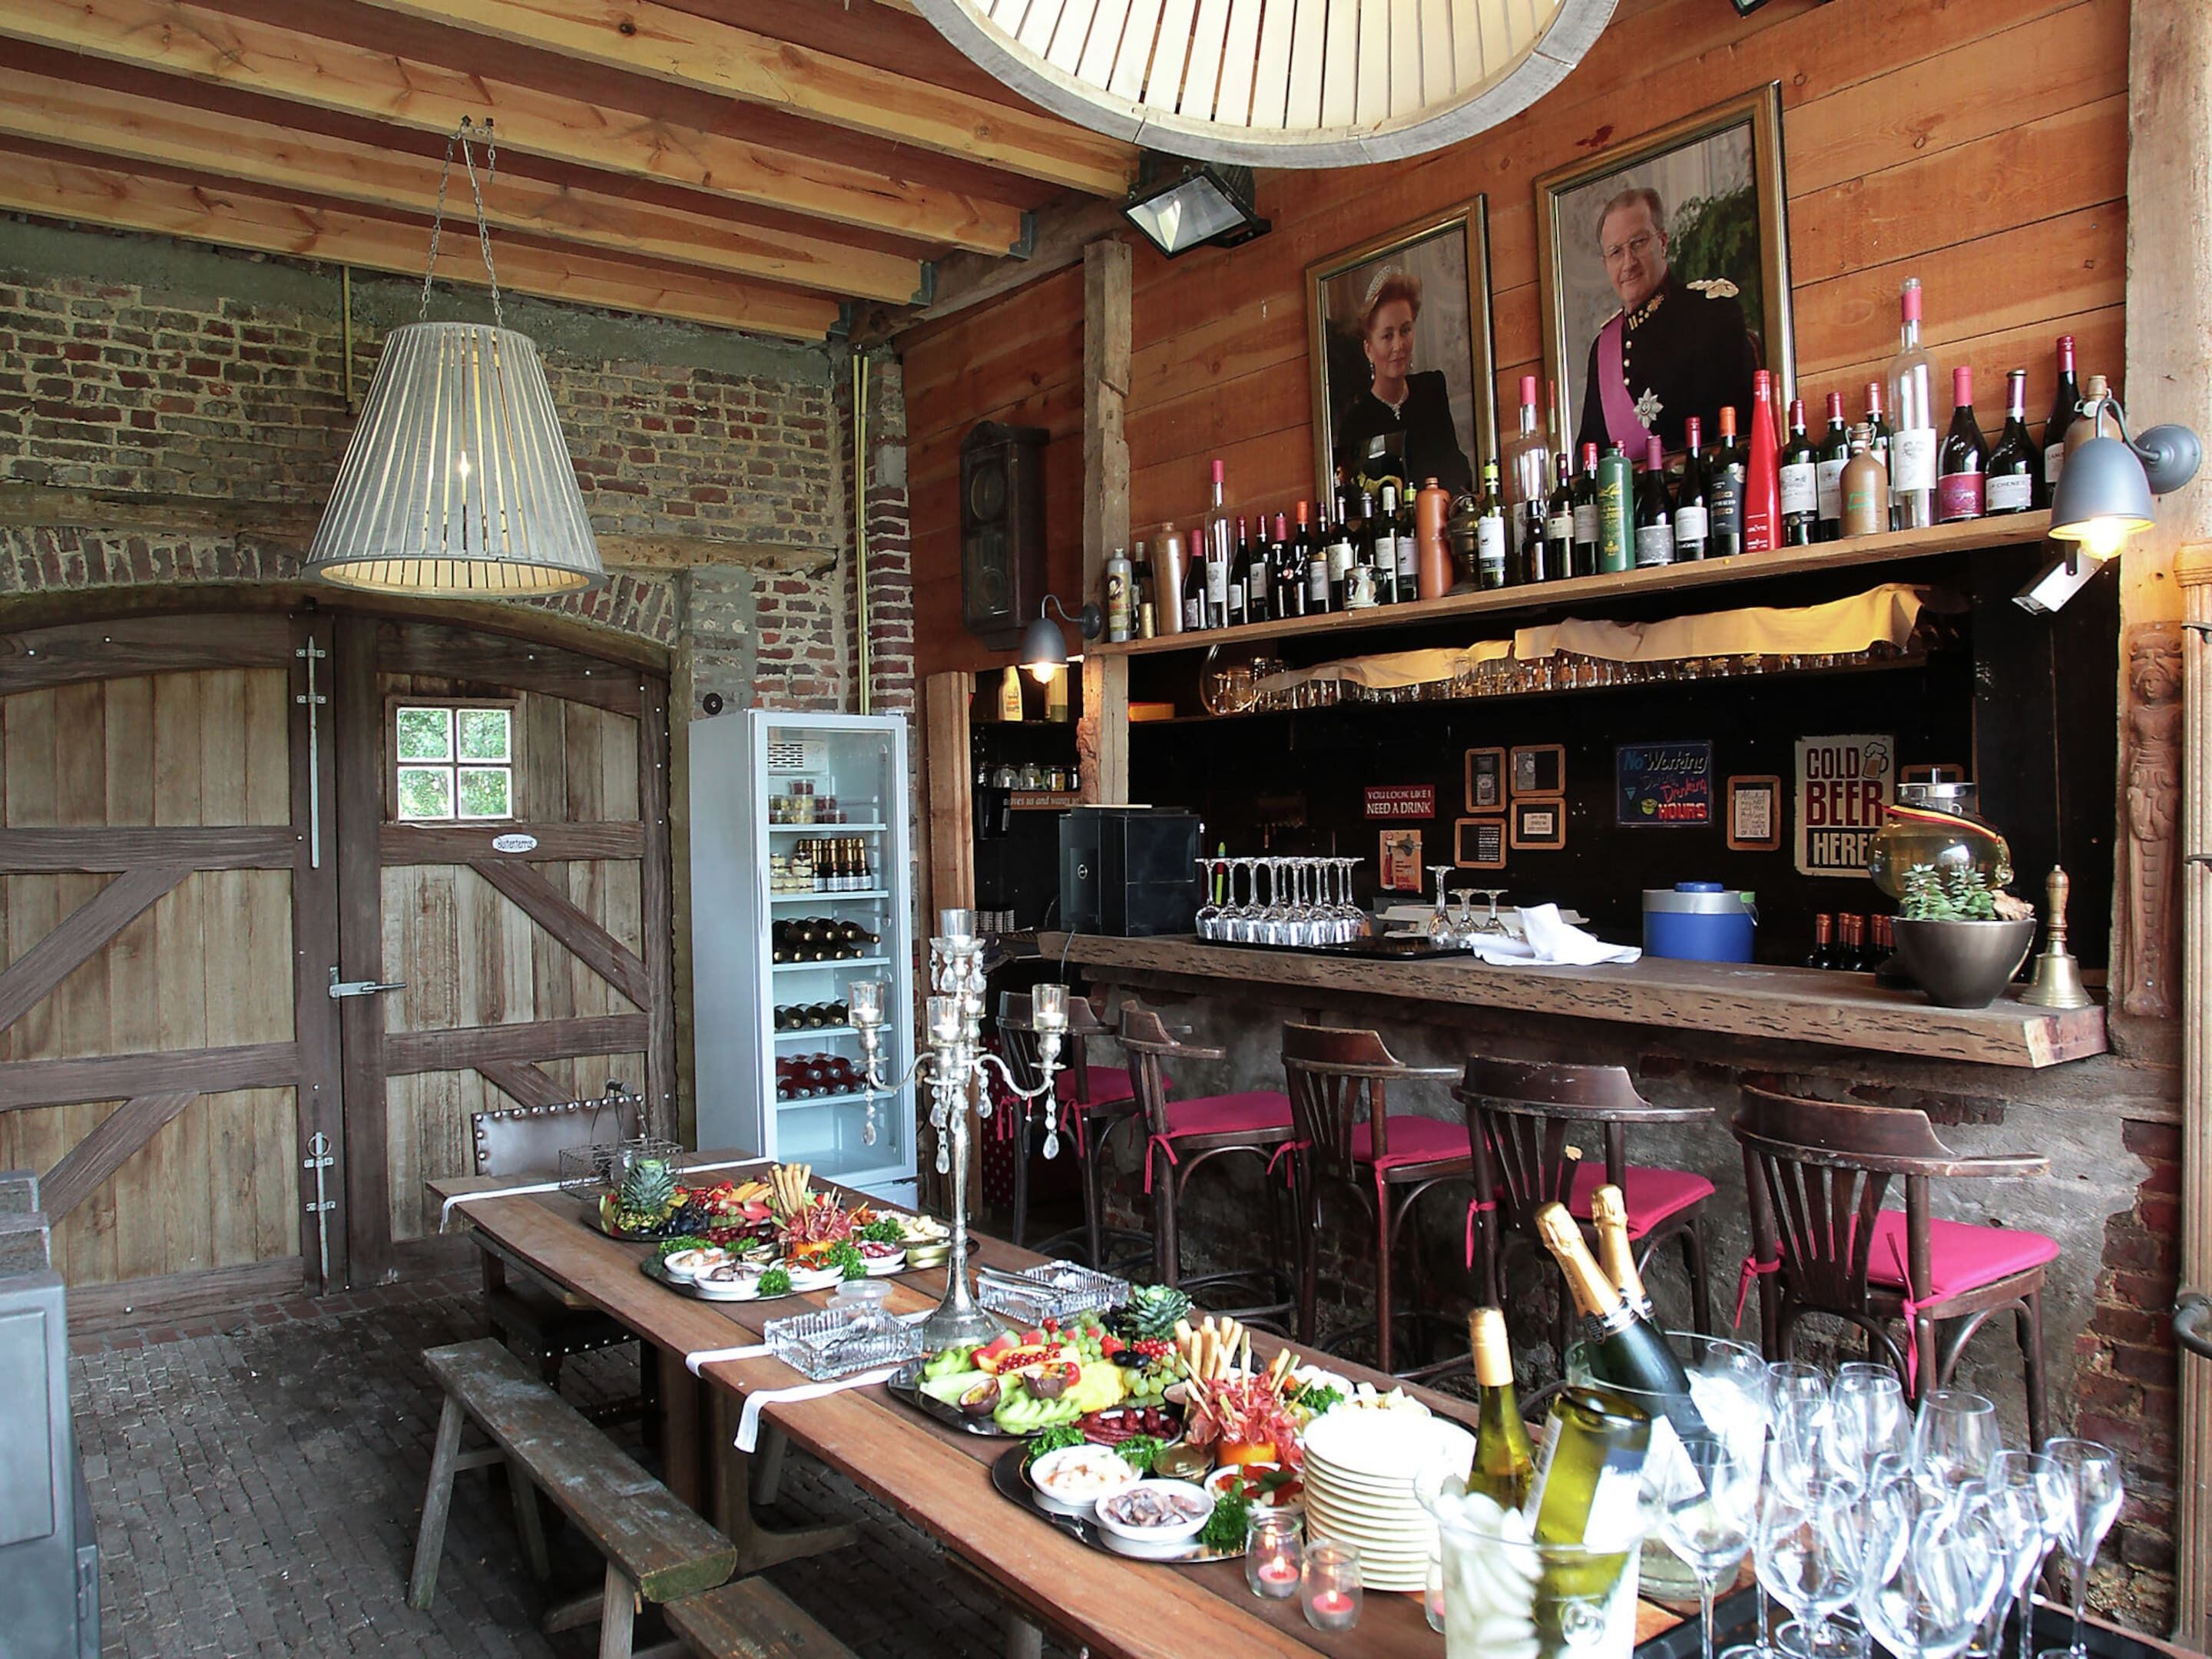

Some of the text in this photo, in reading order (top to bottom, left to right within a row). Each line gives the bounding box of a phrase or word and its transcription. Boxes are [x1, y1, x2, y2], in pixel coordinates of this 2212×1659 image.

[1623, 750, 1708, 774] No Working
[1806, 747, 1859, 779] COLD
[1386, 790, 1409, 799] LOOK
[1410, 790, 1426, 798] LIKE
[1806, 780, 1883, 826] BEER
[1367, 802, 1431, 814] NEED A DRINK
[1658, 802, 1707, 820] HOURS
[1813, 833, 1875, 866] HERE
